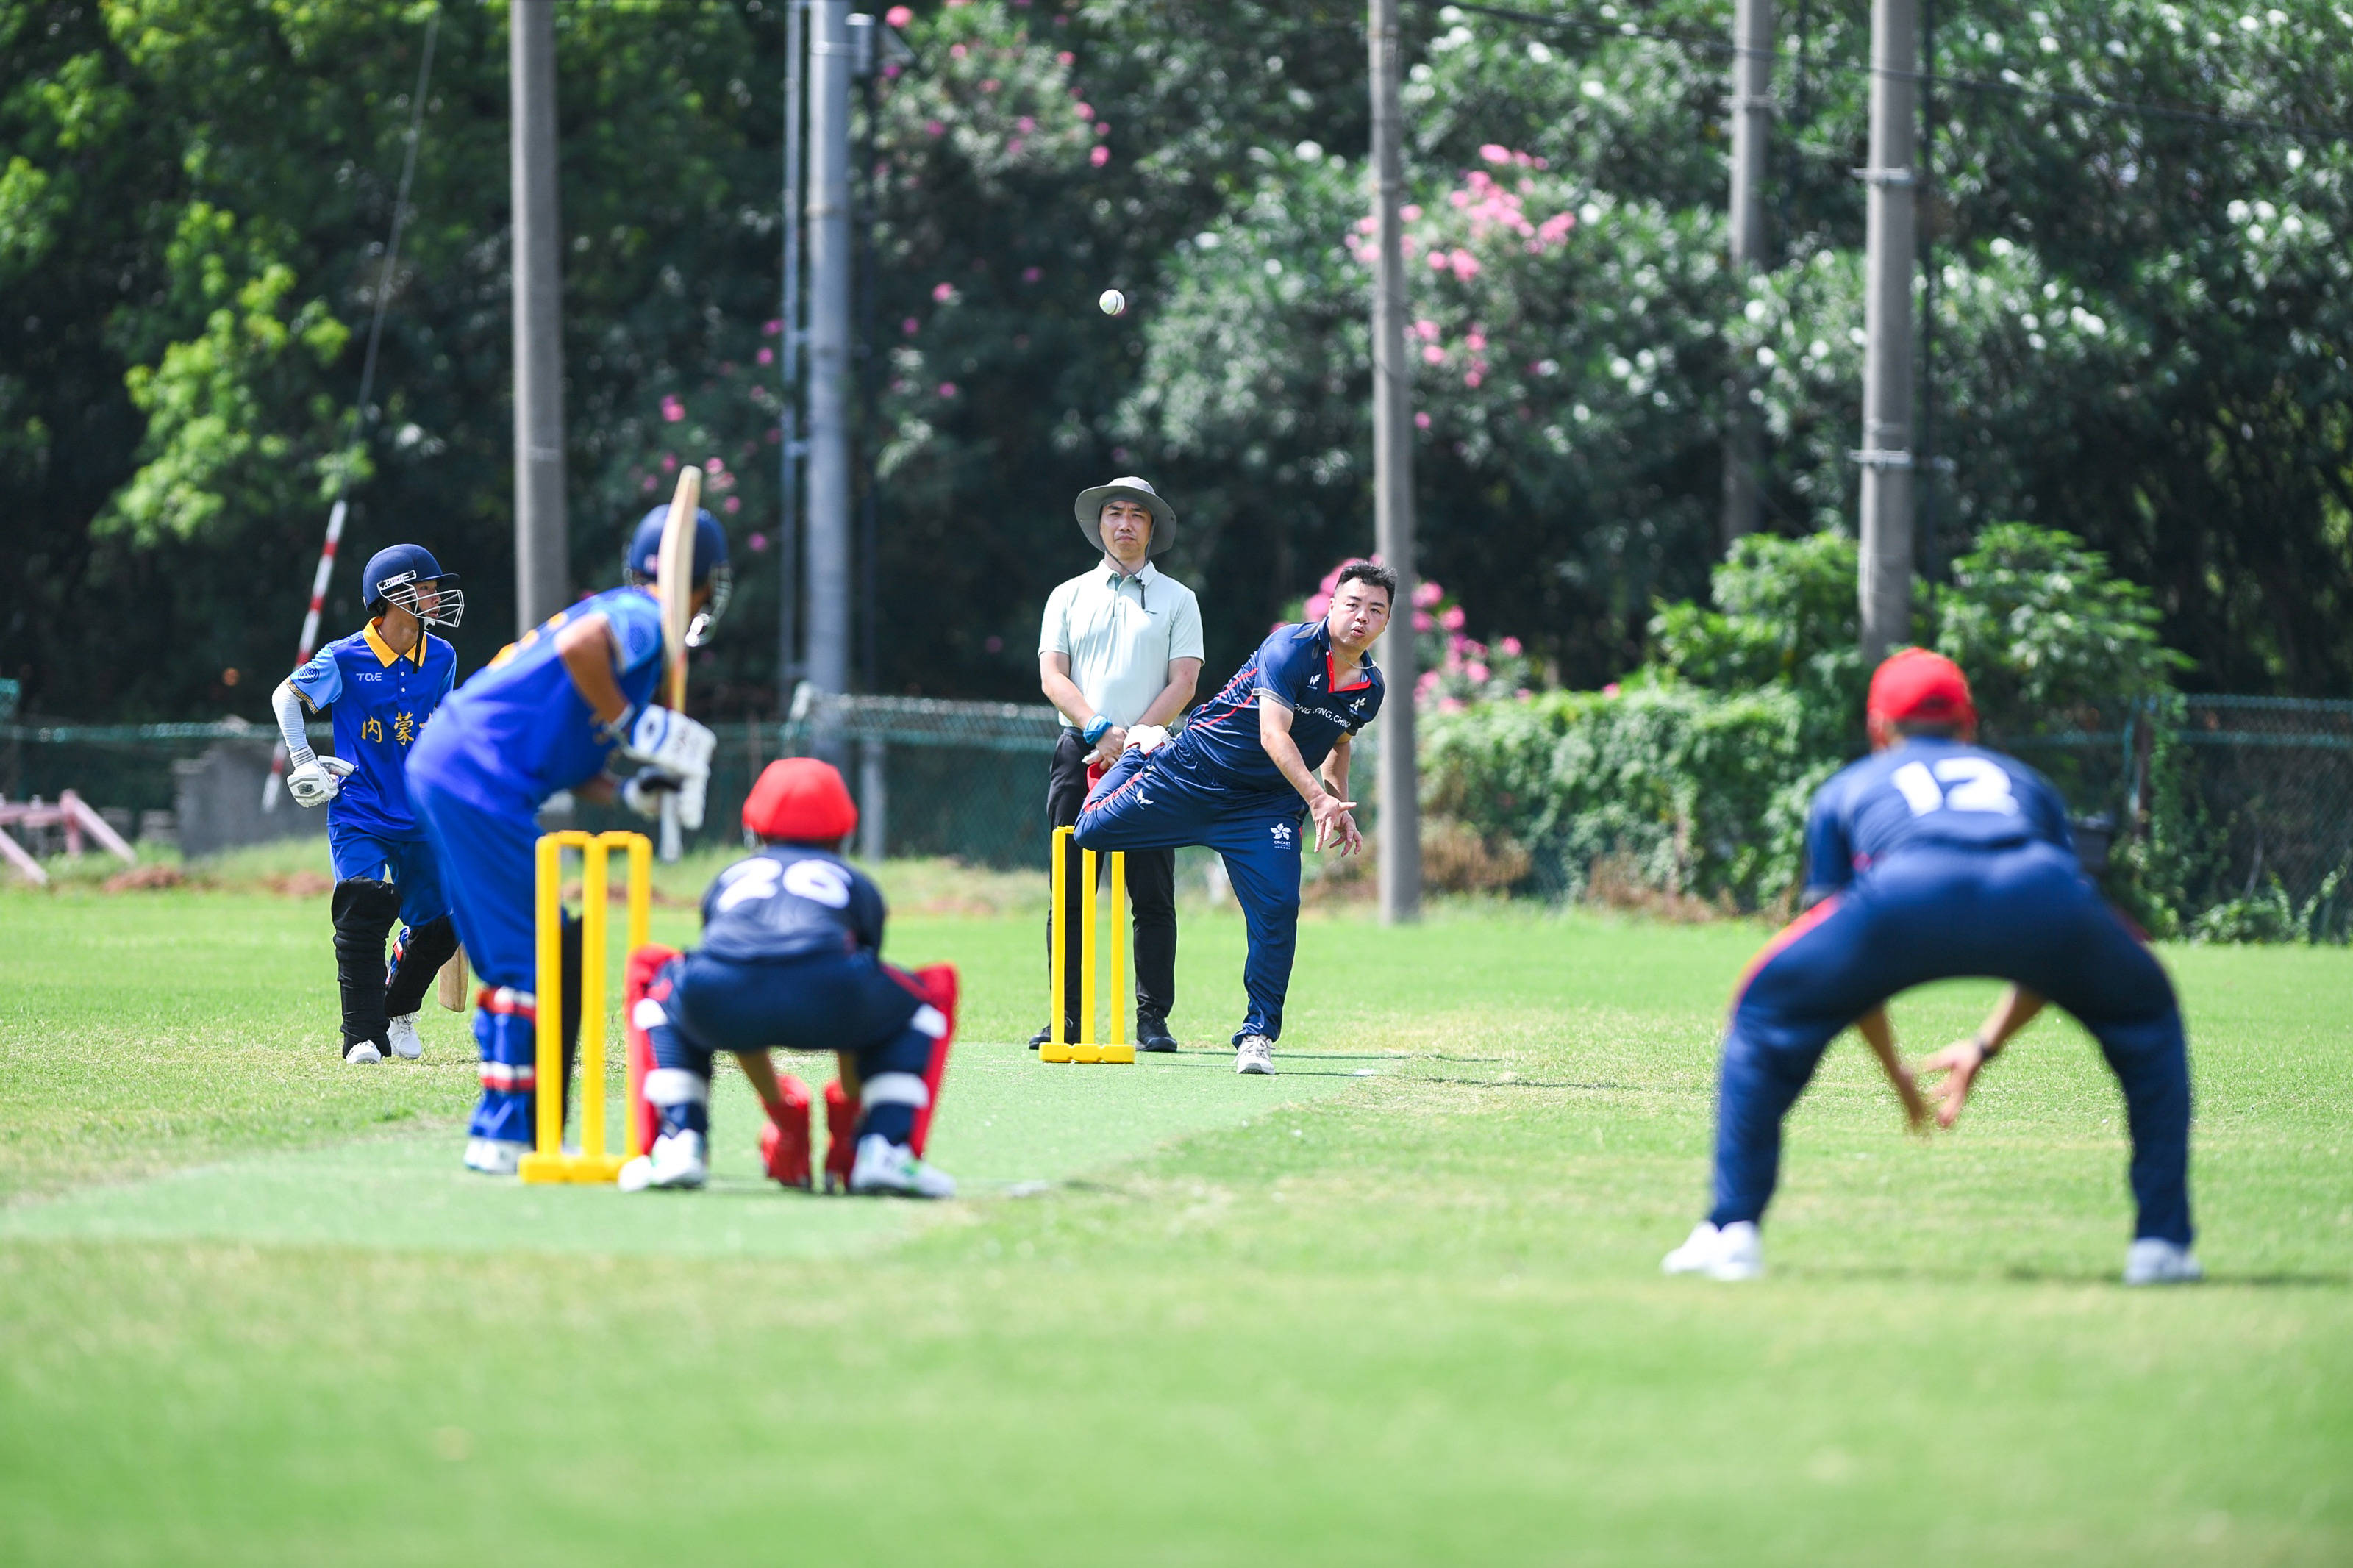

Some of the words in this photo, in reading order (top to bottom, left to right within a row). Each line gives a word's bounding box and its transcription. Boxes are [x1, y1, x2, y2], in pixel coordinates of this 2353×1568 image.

[1294, 703, 1312, 715] ONG
[1312, 706, 1333, 720] ONG,
[1890, 756, 2021, 818] 12
[716, 856, 854, 913] 26
